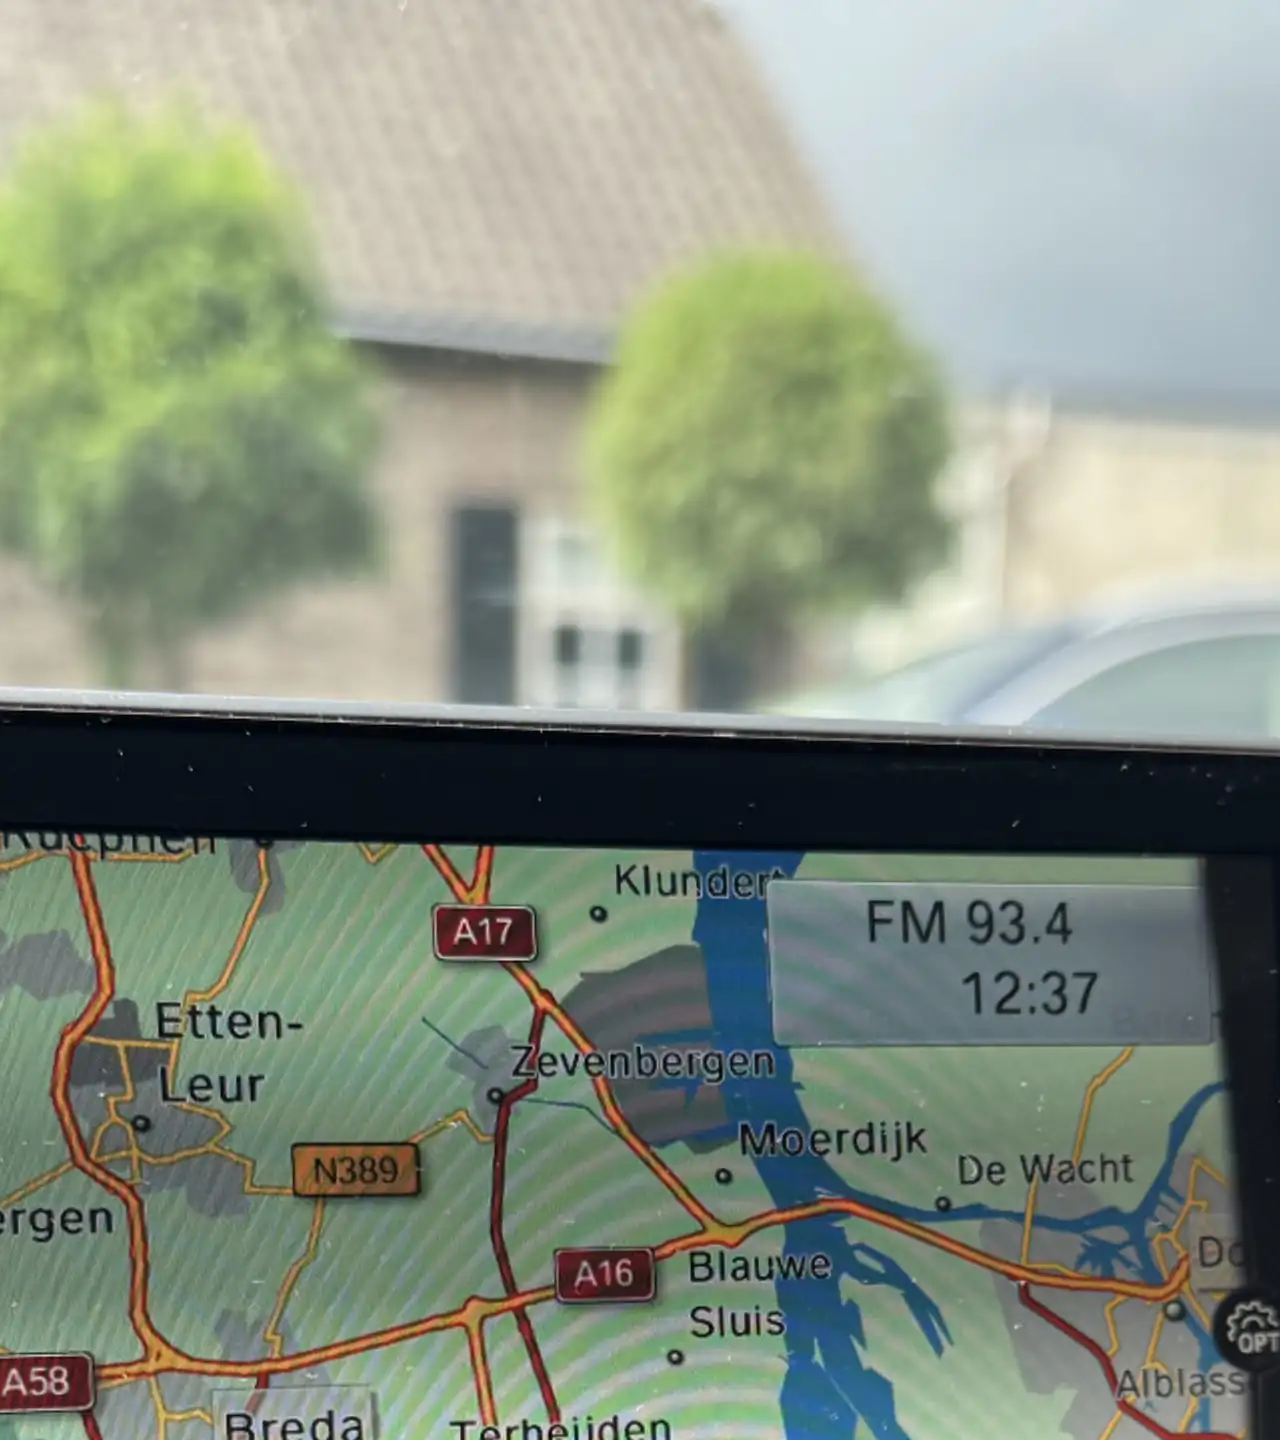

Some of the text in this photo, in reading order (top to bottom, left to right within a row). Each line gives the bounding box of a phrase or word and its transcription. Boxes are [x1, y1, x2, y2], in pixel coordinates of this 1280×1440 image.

[453, 918, 512, 945] A17
[868, 899, 1072, 945] FM 93.4
[963, 971, 1098, 1015] 12:37
[157, 1002, 303, 1039] Etten-
[511, 1045, 774, 1082] Zevenbergen
[160, 1067, 264, 1103] Leur
[739, 1122, 927, 1161] Moerdijk
[314, 1156, 398, 1184] N389
[959, 1153, 1134, 1185] De Wacht
[574, 1258, 633, 1289] A16
[689, 1251, 831, 1281] Blauwe
[689, 1305, 786, 1337] Sluis
[1, 1367, 69, 1397] A58
